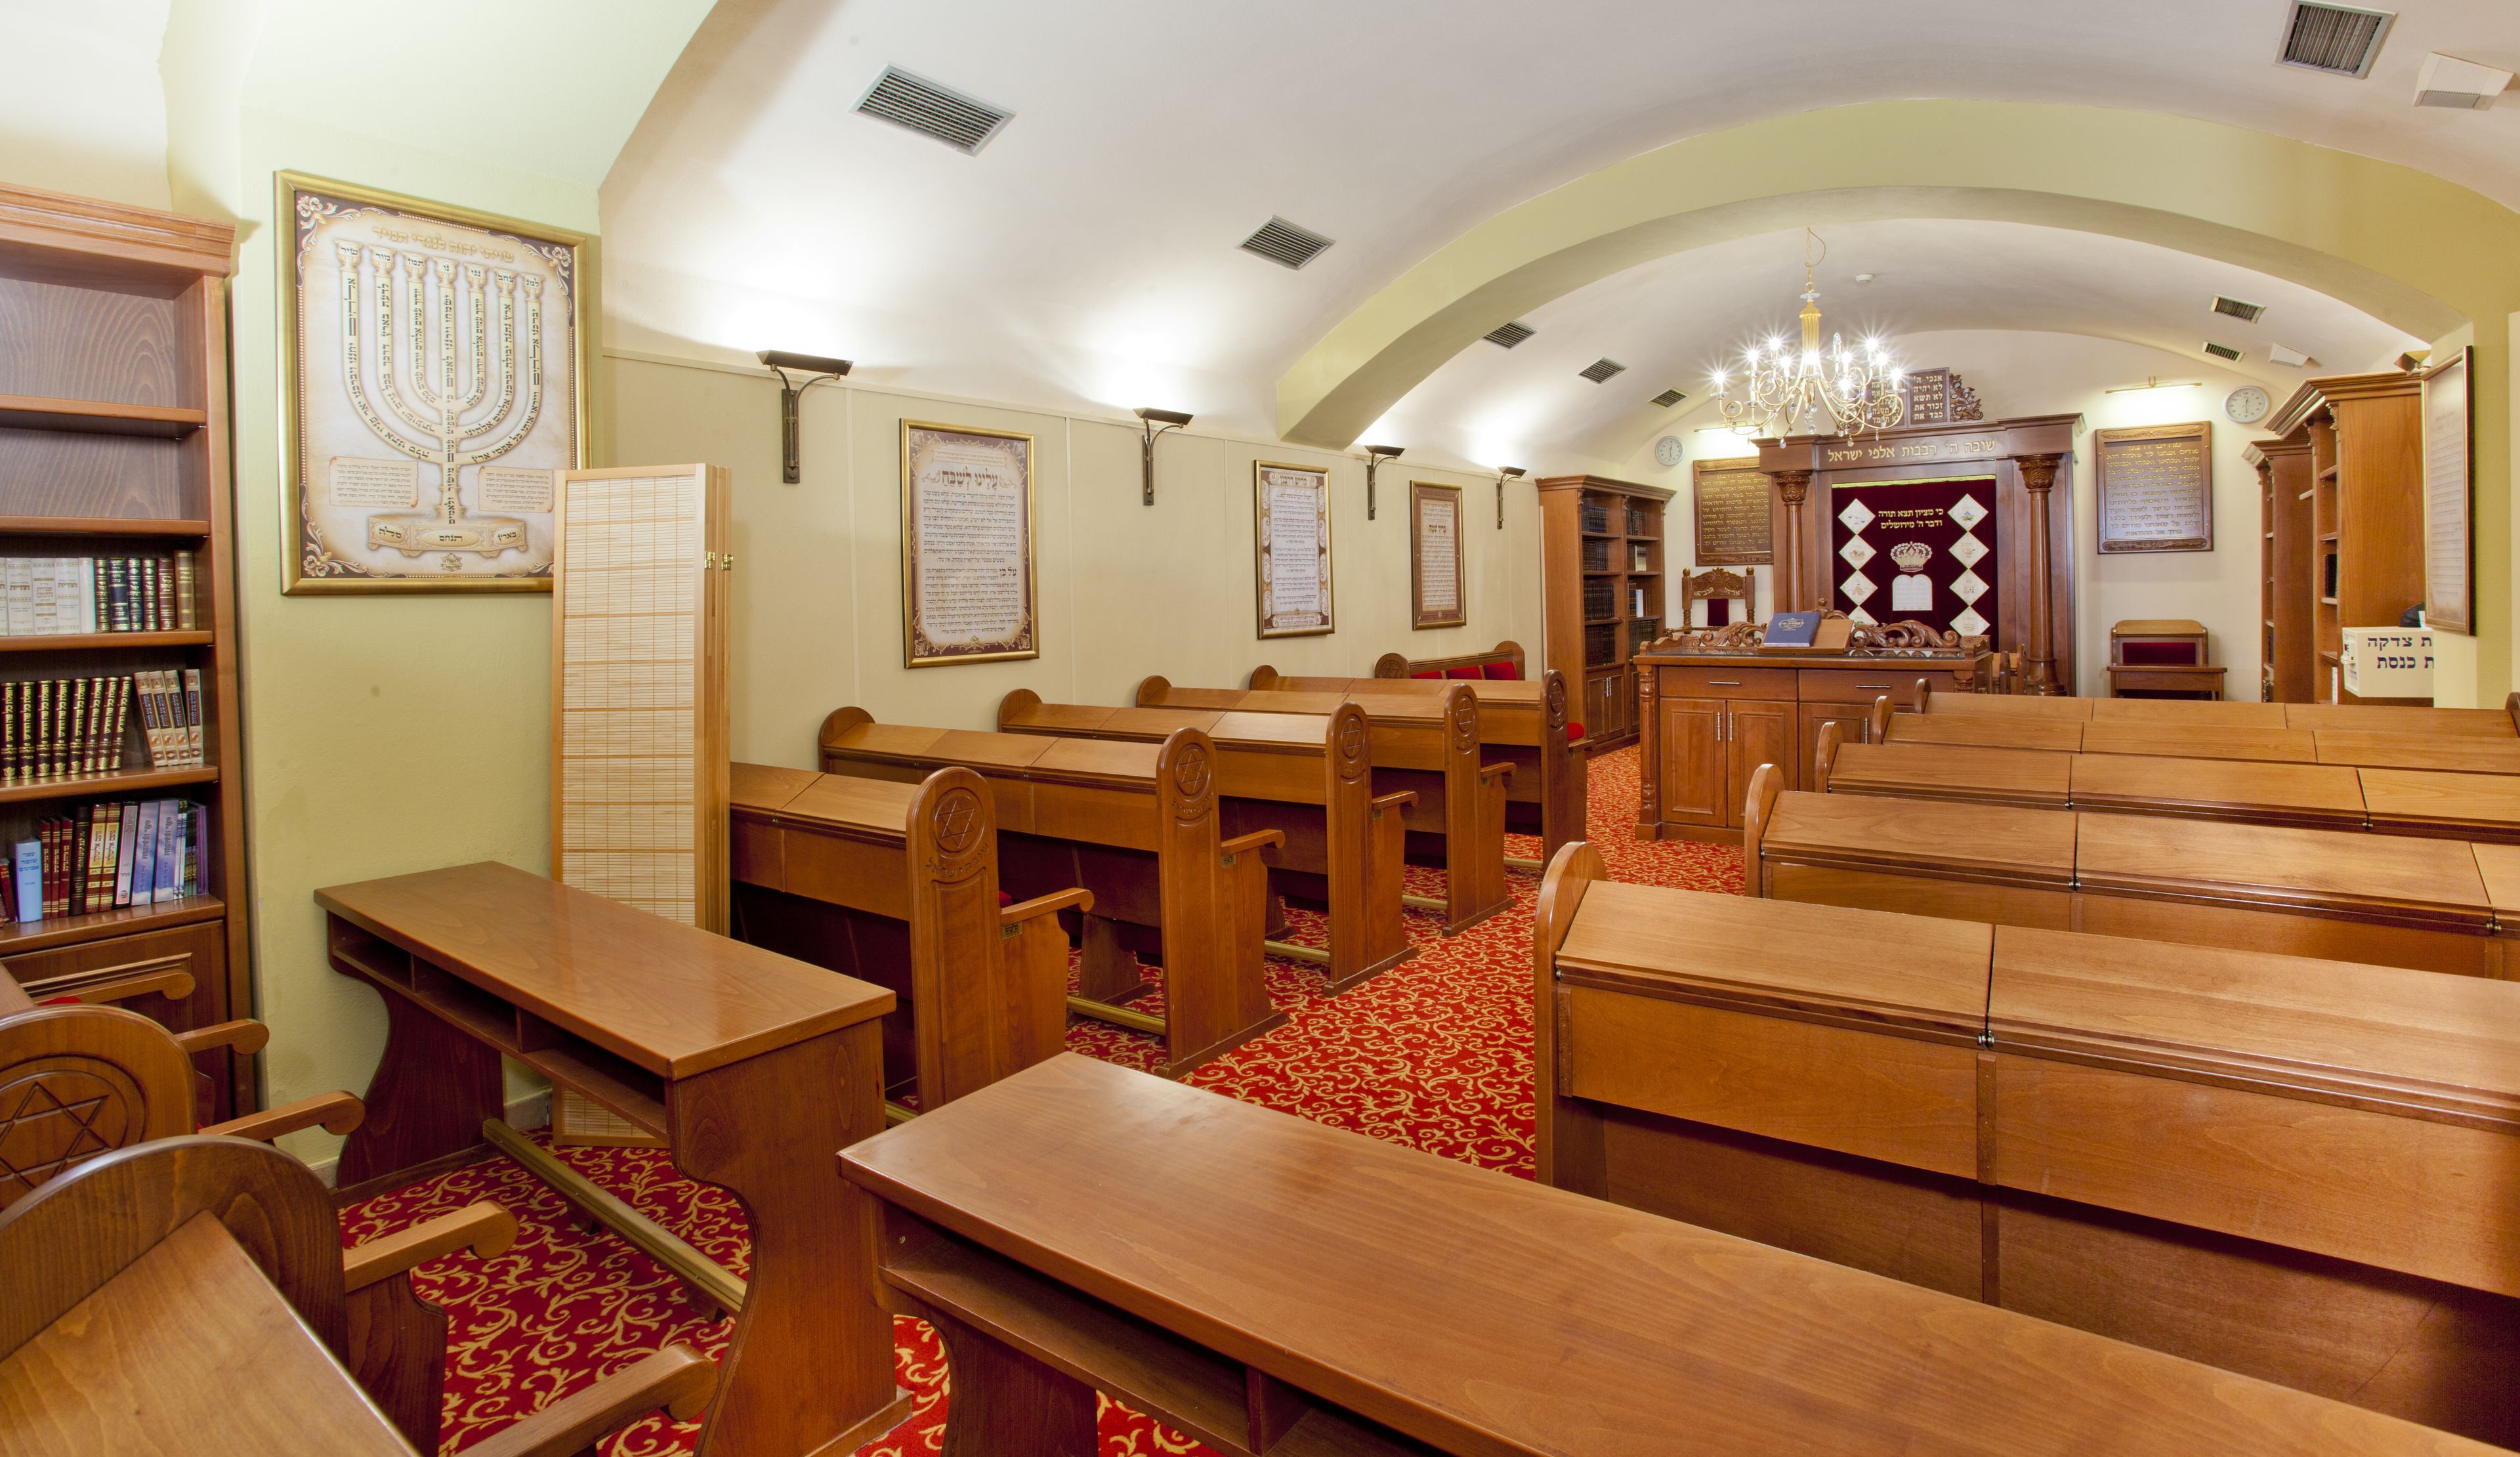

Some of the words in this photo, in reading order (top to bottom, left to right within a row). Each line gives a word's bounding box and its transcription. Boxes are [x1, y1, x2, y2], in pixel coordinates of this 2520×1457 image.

[371, 226, 408, 243] תמיד
[412, 234, 446, 250] לנגדי
[449, 242, 476, 255] יהוה
[340, 246, 358, 256] שיר
[480, 247, 514, 263] שויתי
[377, 284, 390, 308] לדעת
[444, 295, 453, 322] ישמחו
[503, 304, 514, 320] ארץ
[414, 308, 423, 326] עמים
[381, 314, 392, 337] בארץ
[444, 327, 453, 350] וירננו
[383, 344, 393, 367] דרכך
[502, 346, 512, 368] יבולה
[381, 373, 392, 391] בכל
[476, 377, 484, 394] עמים
[1933, 383, 1943, 391] לא
[347, 343, 357, 364] יחננו
[358, 401, 369, 416] יאר
[369, 417, 384, 433] פניו
[385, 432, 406, 449] אתנו
[409, 446, 430, 459] סלה
[387, 392, 403, 410] גוים
[446, 394, 453, 403] כי
[466, 395, 480, 406] כלם
[1933, 392, 1943, 400] לא
[402, 411, 435, 433] ישועתך
[522, 415, 534, 433] אותו
[446, 440, 455, 462] עמים
[492, 441, 513, 454] אפסי
[1868, 445, 1895, 459] אלפי
[1902, 444, 1937, 457] רבבות
[1946, 442, 1958, 454] ה'
[1964, 440, 1995, 452] שובה
[471, 452, 491, 463] ארץ
[1828, 449, 1862, 462] ישראל
[446, 467, 455, 492] מישור
[444, 497, 455, 524] ולאמים
[1915, 509, 1934, 518] מציון
[1881, 520, 1915, 529] מירושלים
[379, 526, 402, 539] סלה
[497, 532, 517, 542] בארץ
[2368, 637, 2412, 651] צדקה
[2377, 656, 2416, 669] כנסת
[1, 705, 13, 713] כל
[20, 704, 32, 713] כל
[38, 702, 49, 711] כל
[55, 701, 66, 710] כל
[74, 700, 84, 709] כל
[89, 699, 100, 708] כל
[104, 698, 115, 707] כל
[117, 698, 127, 707] כל
